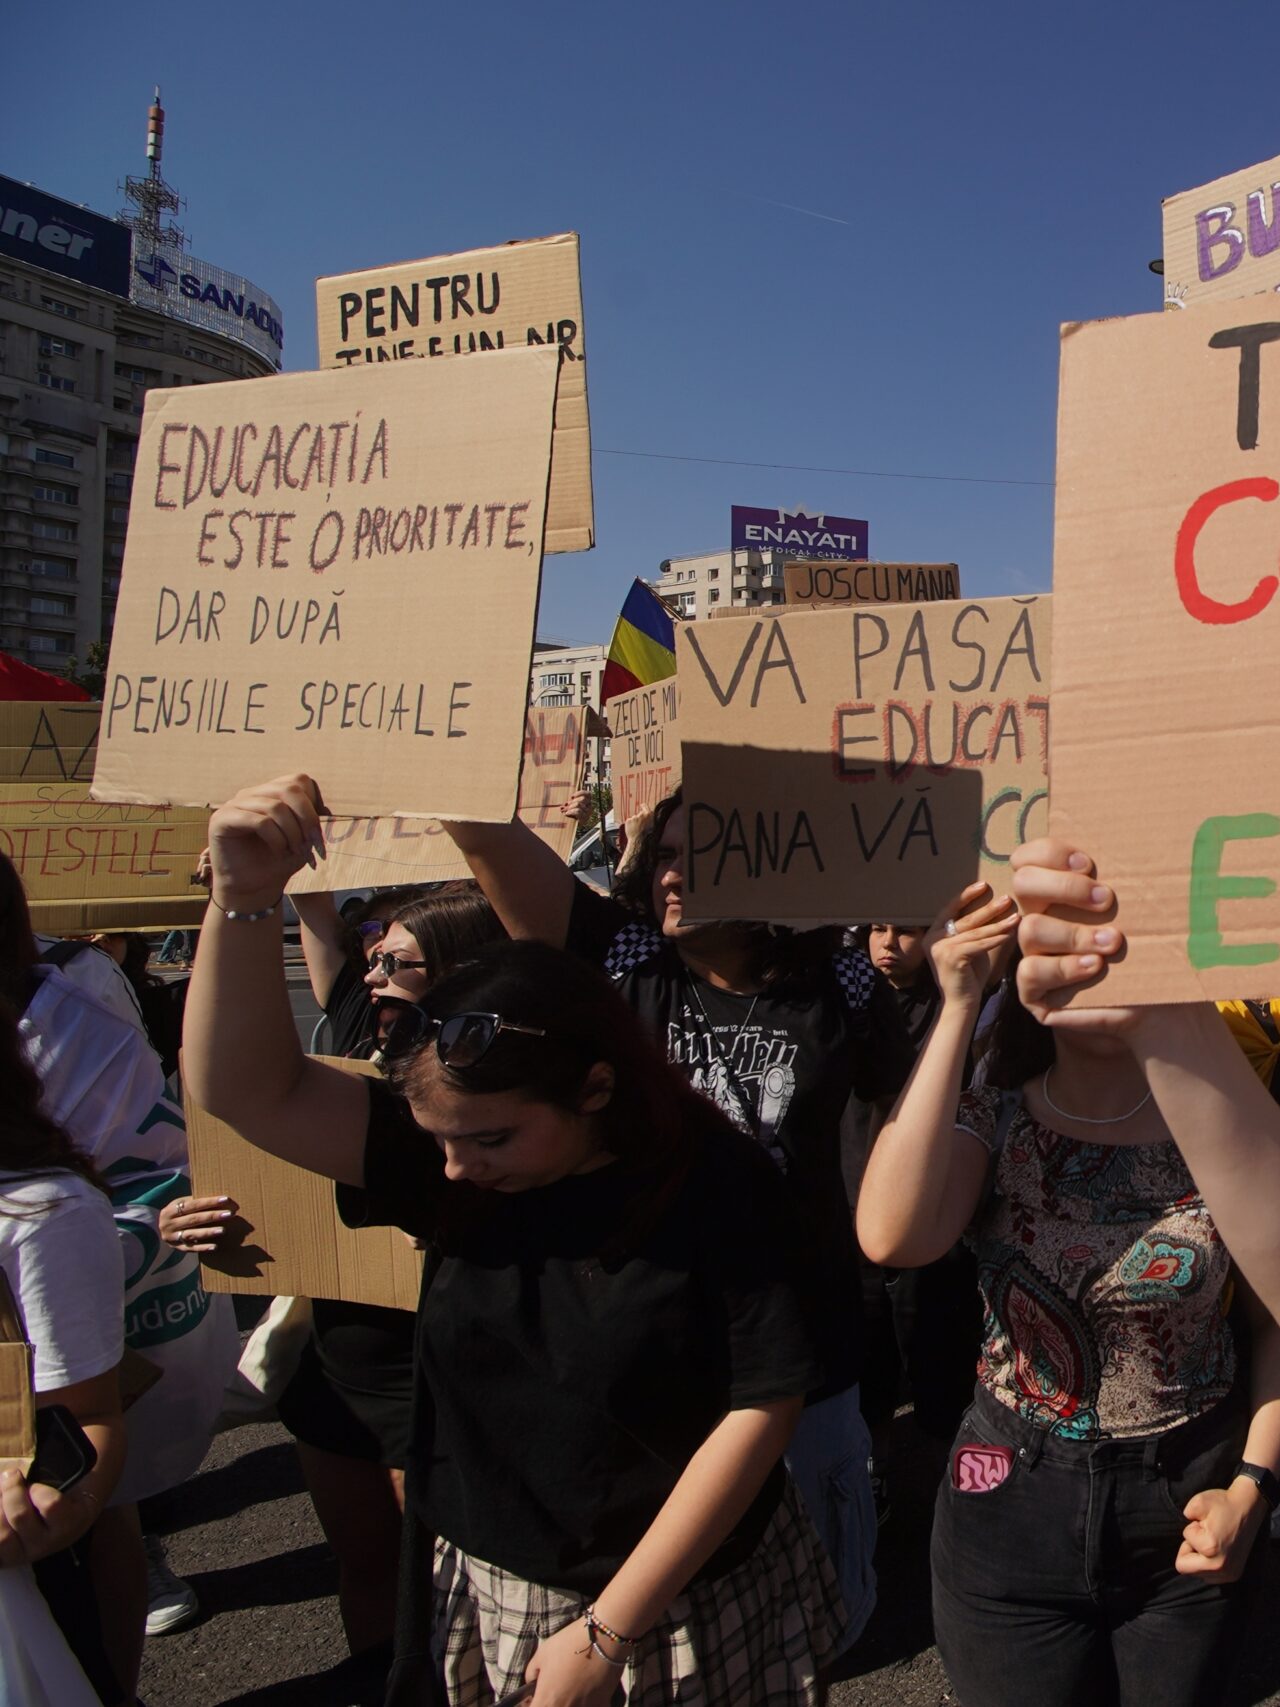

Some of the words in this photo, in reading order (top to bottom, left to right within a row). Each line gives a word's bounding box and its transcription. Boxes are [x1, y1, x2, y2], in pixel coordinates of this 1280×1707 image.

[338, 272, 500, 342] PENTRU
[197, 509, 297, 571] ESTE
[309, 509, 344, 573] O
[352, 502, 535, 562] PRIORITATE,
[745, 524, 857, 550] ENAYATI
[155, 586, 226, 645] DAR
[250, 590, 345, 645] DUPĂ
[107, 674, 268, 739] PENSIILE
[296, 680, 473, 739] SPECIALE
[642, 690, 658, 730] DE
[628, 735, 641, 768] DE
[688, 802, 825, 893] PANA
[852, 786, 938, 863] VĂ
